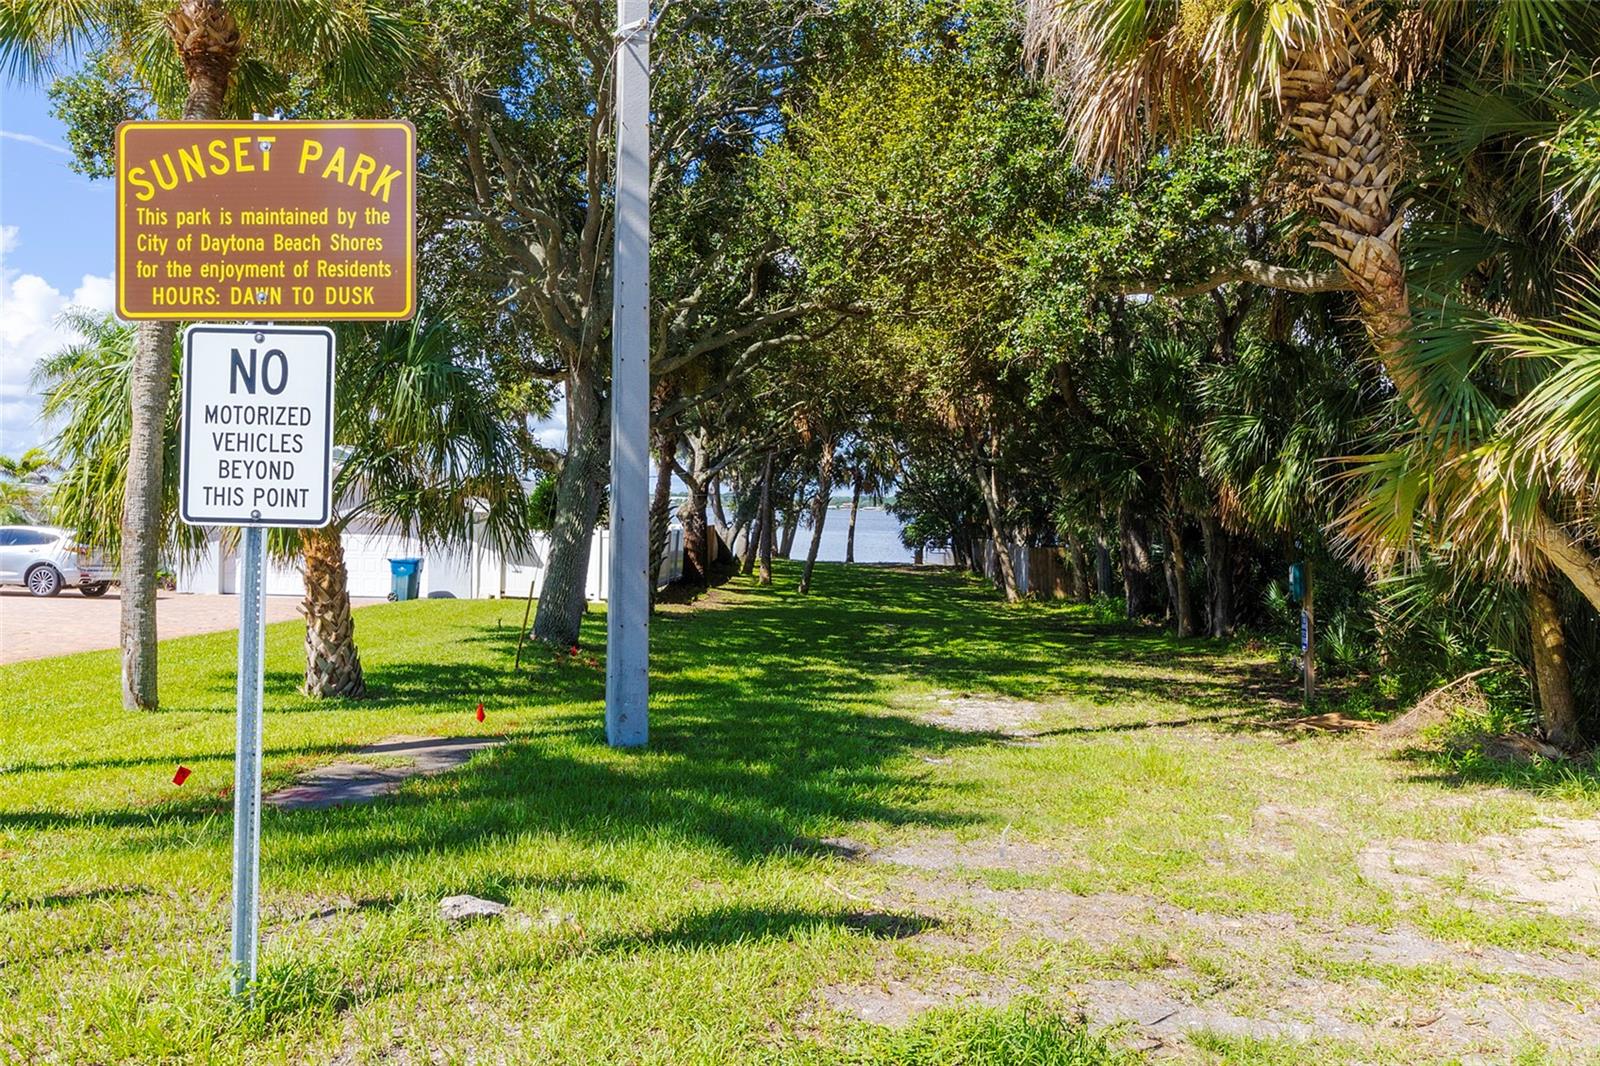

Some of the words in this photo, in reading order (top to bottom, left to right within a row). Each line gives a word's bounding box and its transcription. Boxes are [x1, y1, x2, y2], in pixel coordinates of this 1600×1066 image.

[128, 136, 276, 201] SUNSET
[298, 139, 402, 203] PARK
[136, 208, 168, 225] This
[176, 208, 211, 229] park
[220, 208, 232, 225] is
[241, 208, 328, 225] maintained
[337, 208, 356, 229] by
[365, 208, 390, 225] the
[137, 234, 168, 256] City
[176, 234, 193, 251] of
[201, 234, 264, 256] Daytona
[273, 234, 321, 251] Beach
[330, 234, 383, 251] Shores
[136, 260, 158, 278] for
[166, 260, 192, 278] the
[200, 260, 285, 282] enjoyment
[293, 260, 309, 277] of
[317, 260, 392, 277] Residents
[152, 287, 220, 305] HOURS:
[230, 287, 282, 305] DAWN
[292, 287, 314, 305] TO
[325, 286, 375, 305] DUSK
[229, 348, 289, 395] NO
[204, 405, 312, 426] MOTORIZED
[212, 432, 304, 454] VEHICLES
[218, 459, 295, 480] BEYOND
[203, 486, 244, 507] THIS
[253, 487, 310, 508] POINT
